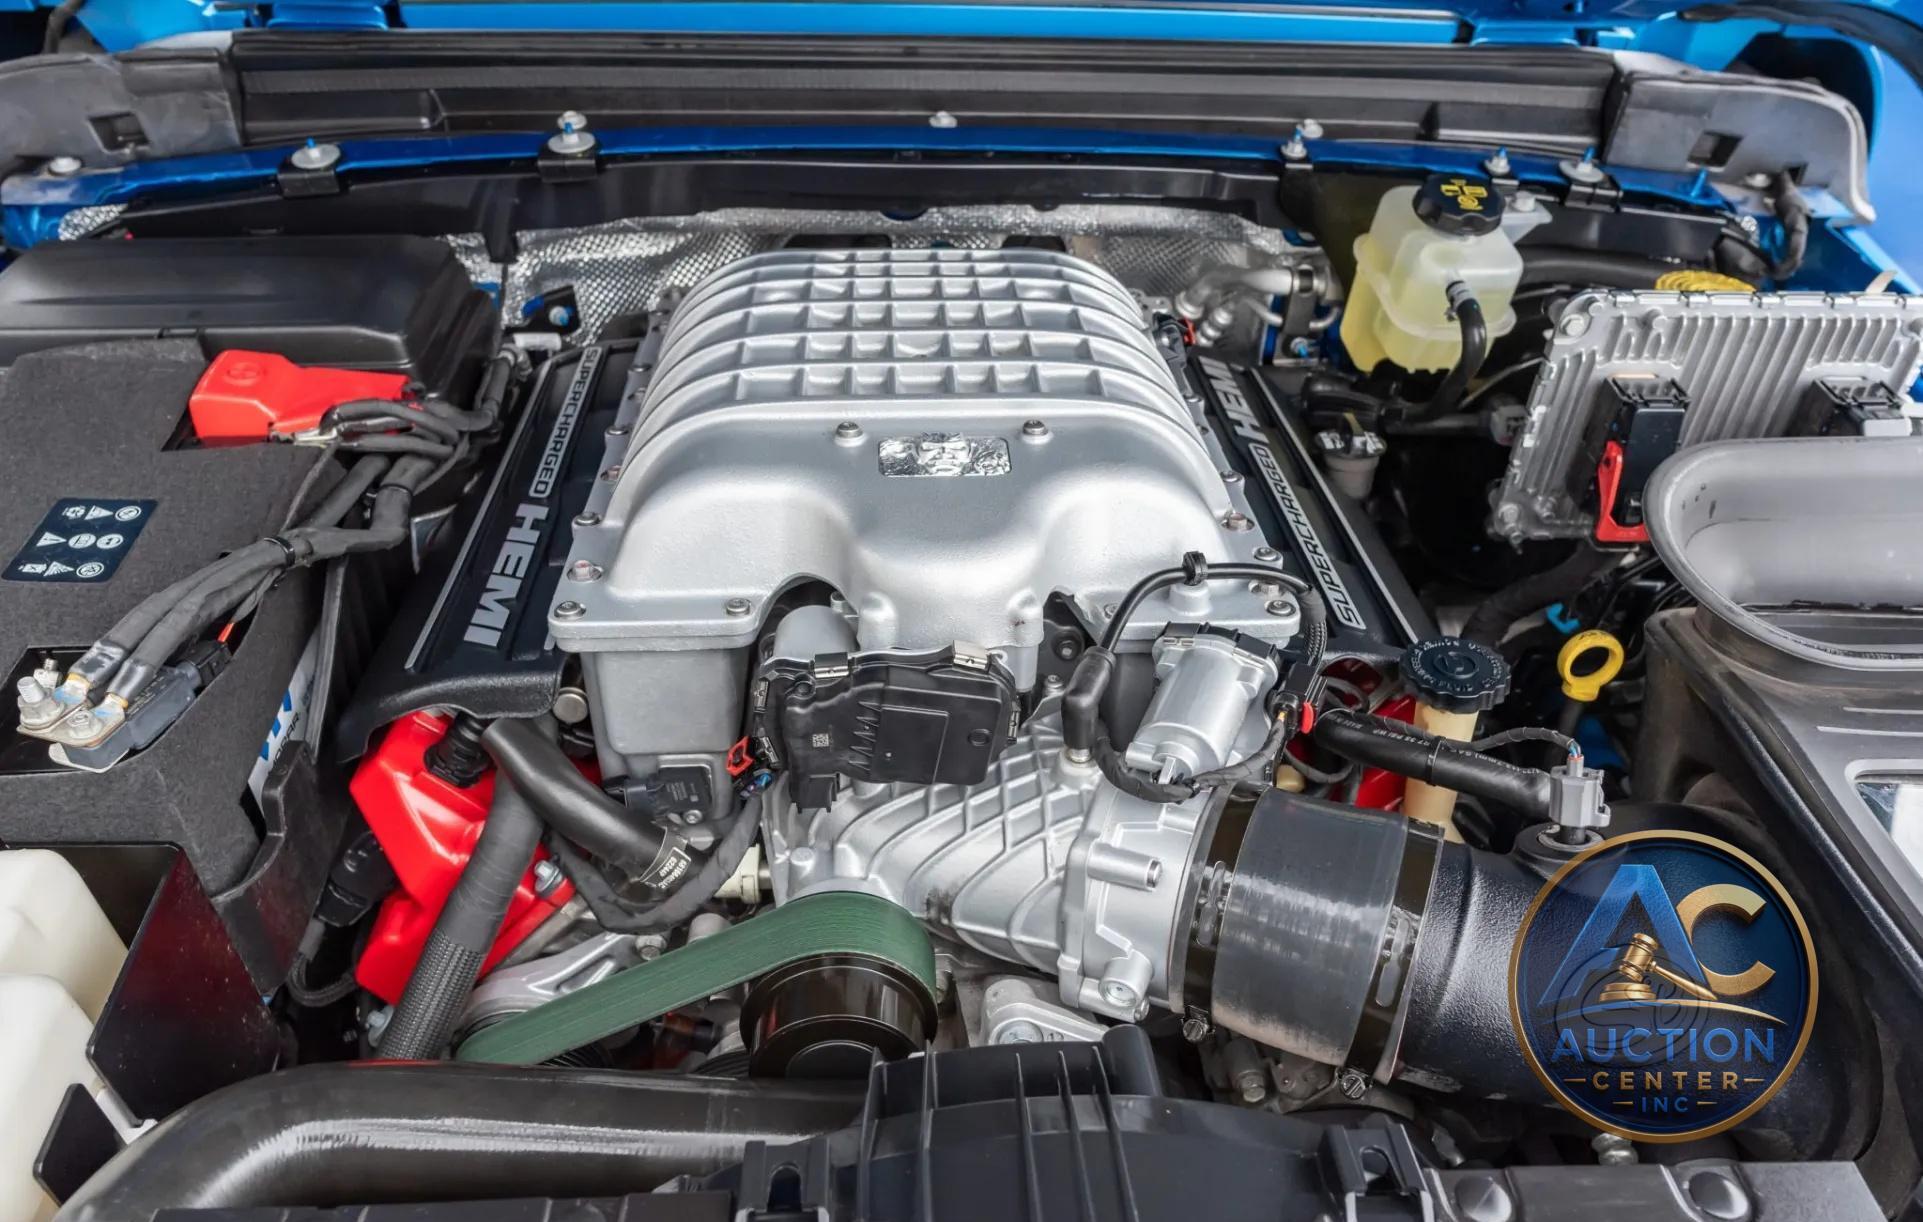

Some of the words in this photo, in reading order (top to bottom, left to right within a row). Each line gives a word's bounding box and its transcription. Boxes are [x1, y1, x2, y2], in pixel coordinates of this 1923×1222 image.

[533, 350, 599, 495] SUPERCHARGED
[1199, 356, 1270, 444] HEMI
[463, 503, 549, 647] HEMI
[1252, 444, 1362, 627] SUPERCHARGED
